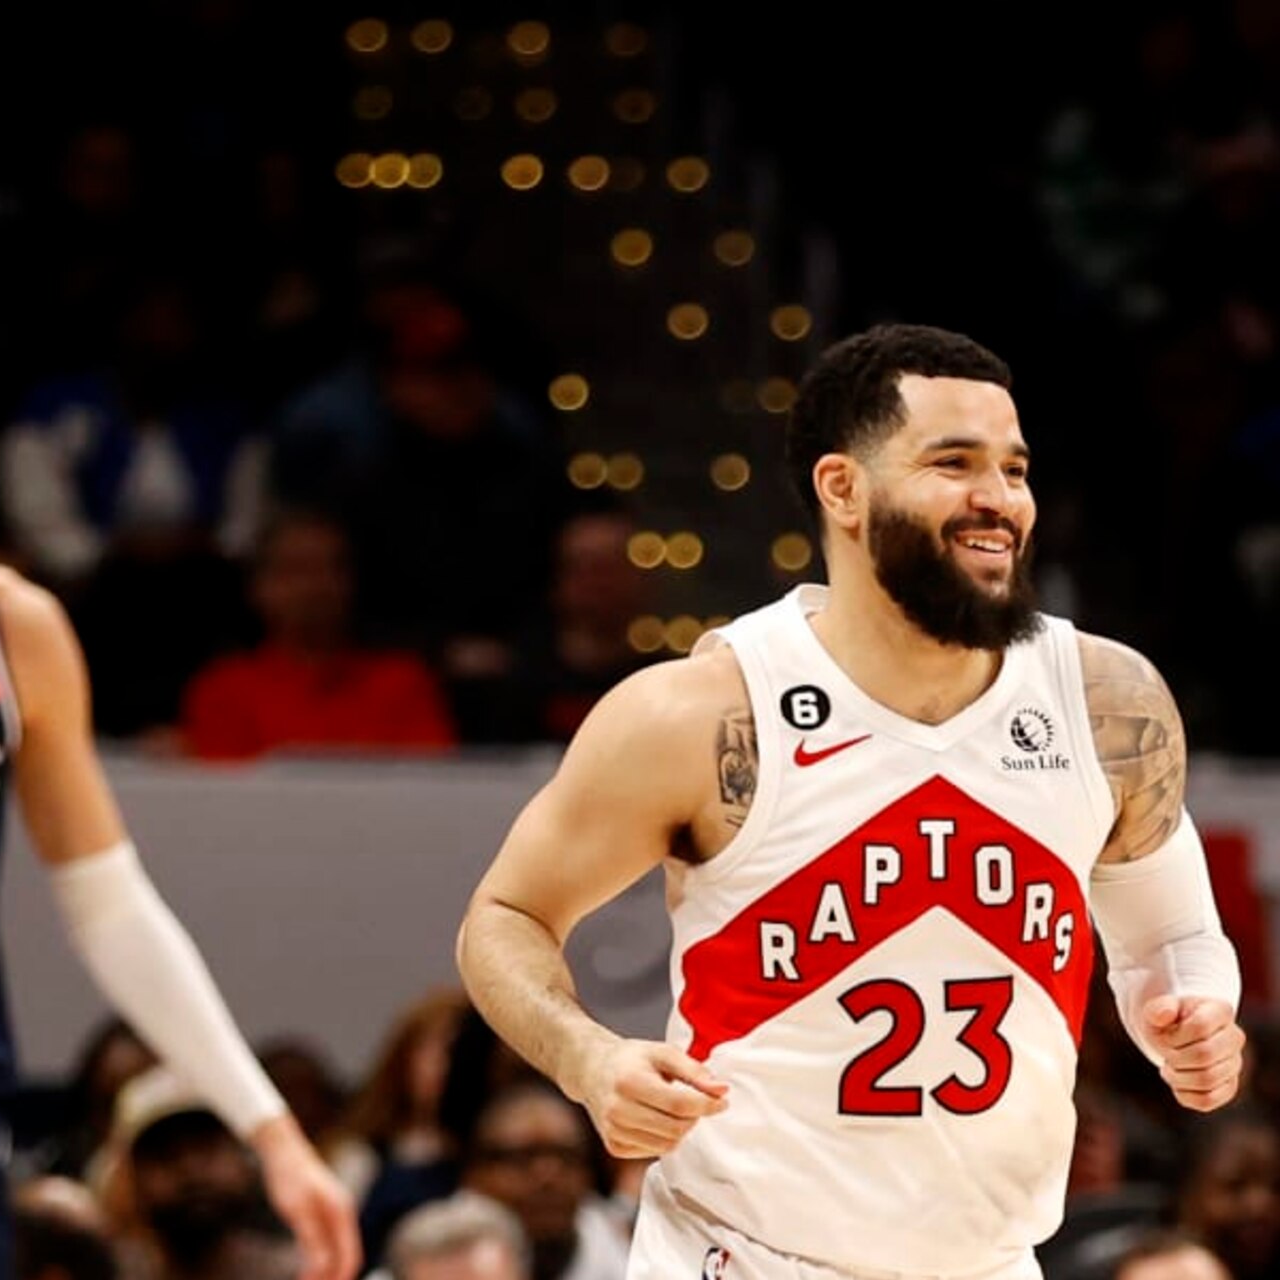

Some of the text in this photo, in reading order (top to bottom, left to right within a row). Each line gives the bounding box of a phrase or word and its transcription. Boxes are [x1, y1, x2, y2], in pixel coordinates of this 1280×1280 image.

[791, 691, 819, 726] 6
[1001, 753, 1070, 771] Sun Life
[758, 817, 1075, 982] RAPTORS
[836, 974, 1014, 1117] 23
